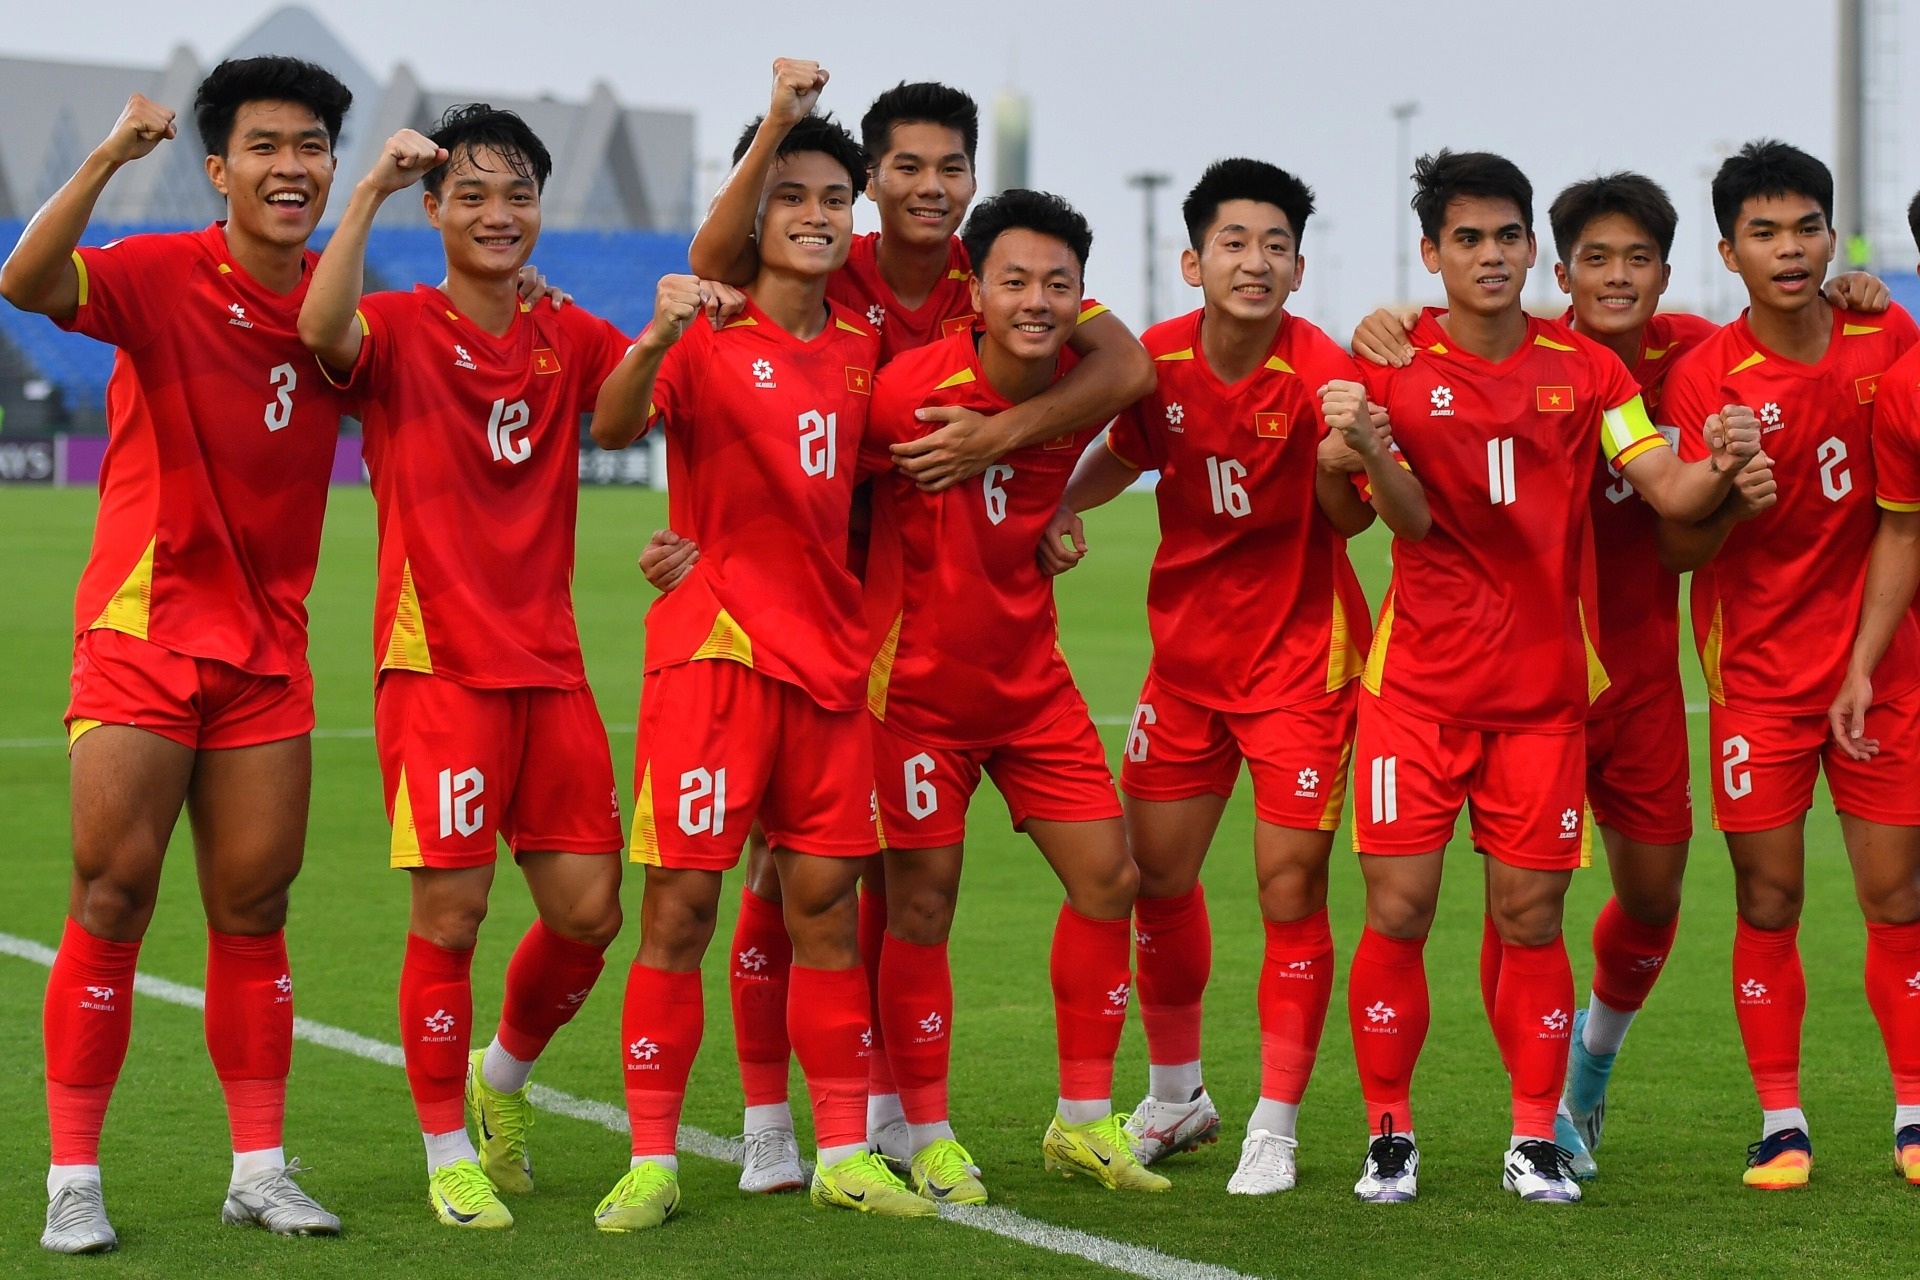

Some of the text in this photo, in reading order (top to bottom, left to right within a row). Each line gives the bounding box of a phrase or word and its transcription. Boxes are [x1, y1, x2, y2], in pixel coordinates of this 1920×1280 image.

[264, 363, 297, 432] 3
[487, 398, 532, 465] 12
[798, 409, 837, 480] 21
[1487, 437, 1516, 506] 11
[1816, 436, 1852, 502] 2
[983, 465, 1015, 526] 6
[1206, 456, 1252, 518] 16
[678, 767, 726, 837] 21
[903, 752, 938, 821] 6
[1371, 755, 1398, 824] 11
[1722, 735, 1752, 801] 2
[438, 767, 484, 839] 12
